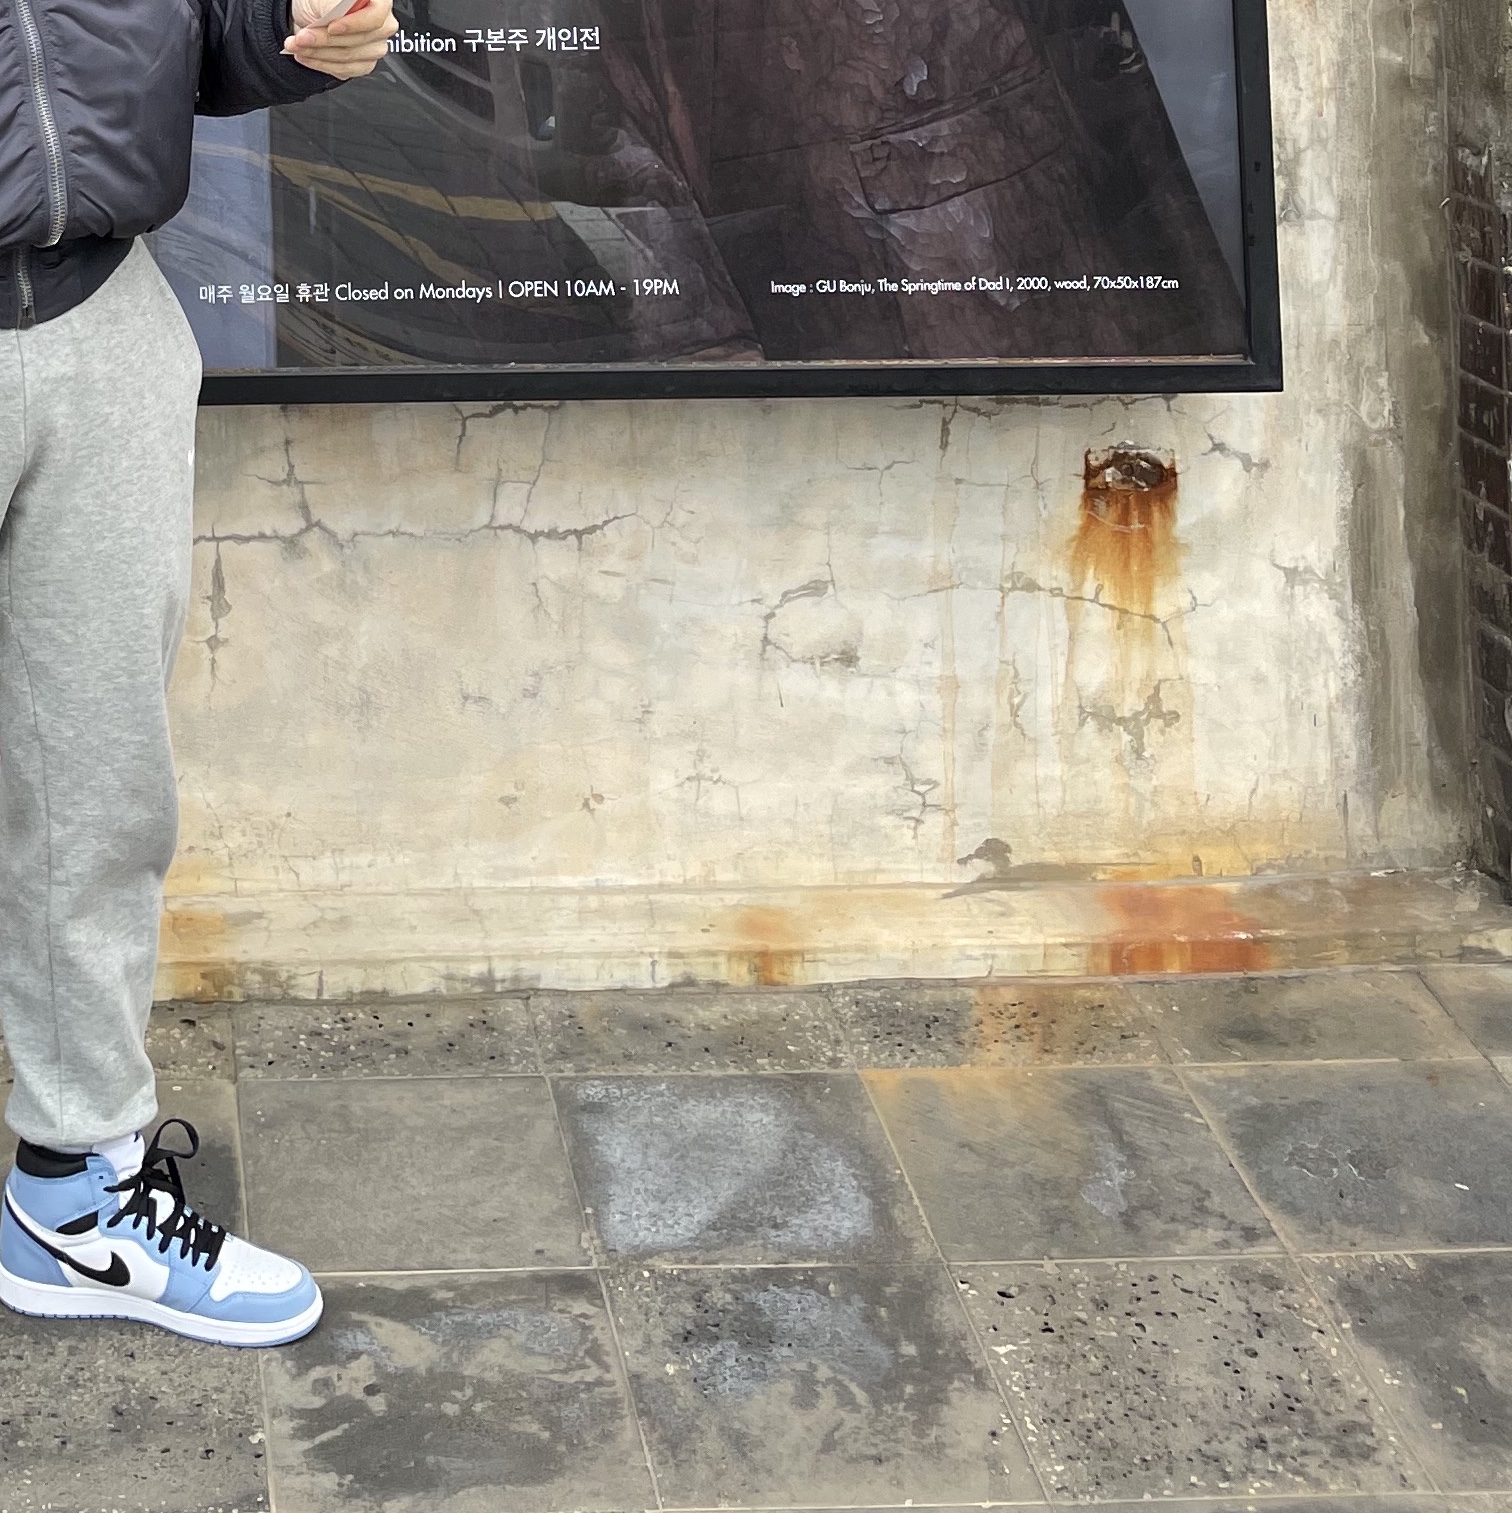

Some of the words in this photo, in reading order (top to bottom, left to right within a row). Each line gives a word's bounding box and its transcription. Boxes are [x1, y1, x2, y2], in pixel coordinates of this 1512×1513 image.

[464, 28, 529, 54] 구본주
[535, 26, 601, 52] 개인전
[199, 284, 234, 304] 매주
[238, 283, 290, 304] 월요일
[295, 282, 331, 304] 휴관
[335, 283, 390, 302] Closed
[395, 286, 416, 301] on
[419, 282, 493, 304] Mondays
[508, 280, 558, 298] OPEN
[565, 279, 615, 298] 10AM
[633, 278, 680, 297] 19PM
[771, 280, 807, 296] Image
[815, 279, 837, 294] GU
[839, 279, 875, 296] Bonju,
[877, 278, 899, 293] The
[901, 277, 962, 296] Springtime
[964, 277, 977, 291] of
[978, 277, 1004, 291] Dad
[1016, 276, 1052, 294] 2000,
[1054, 275, 1091, 293] wood,
[1093, 275, 1179, 291] 70x50x187cm
